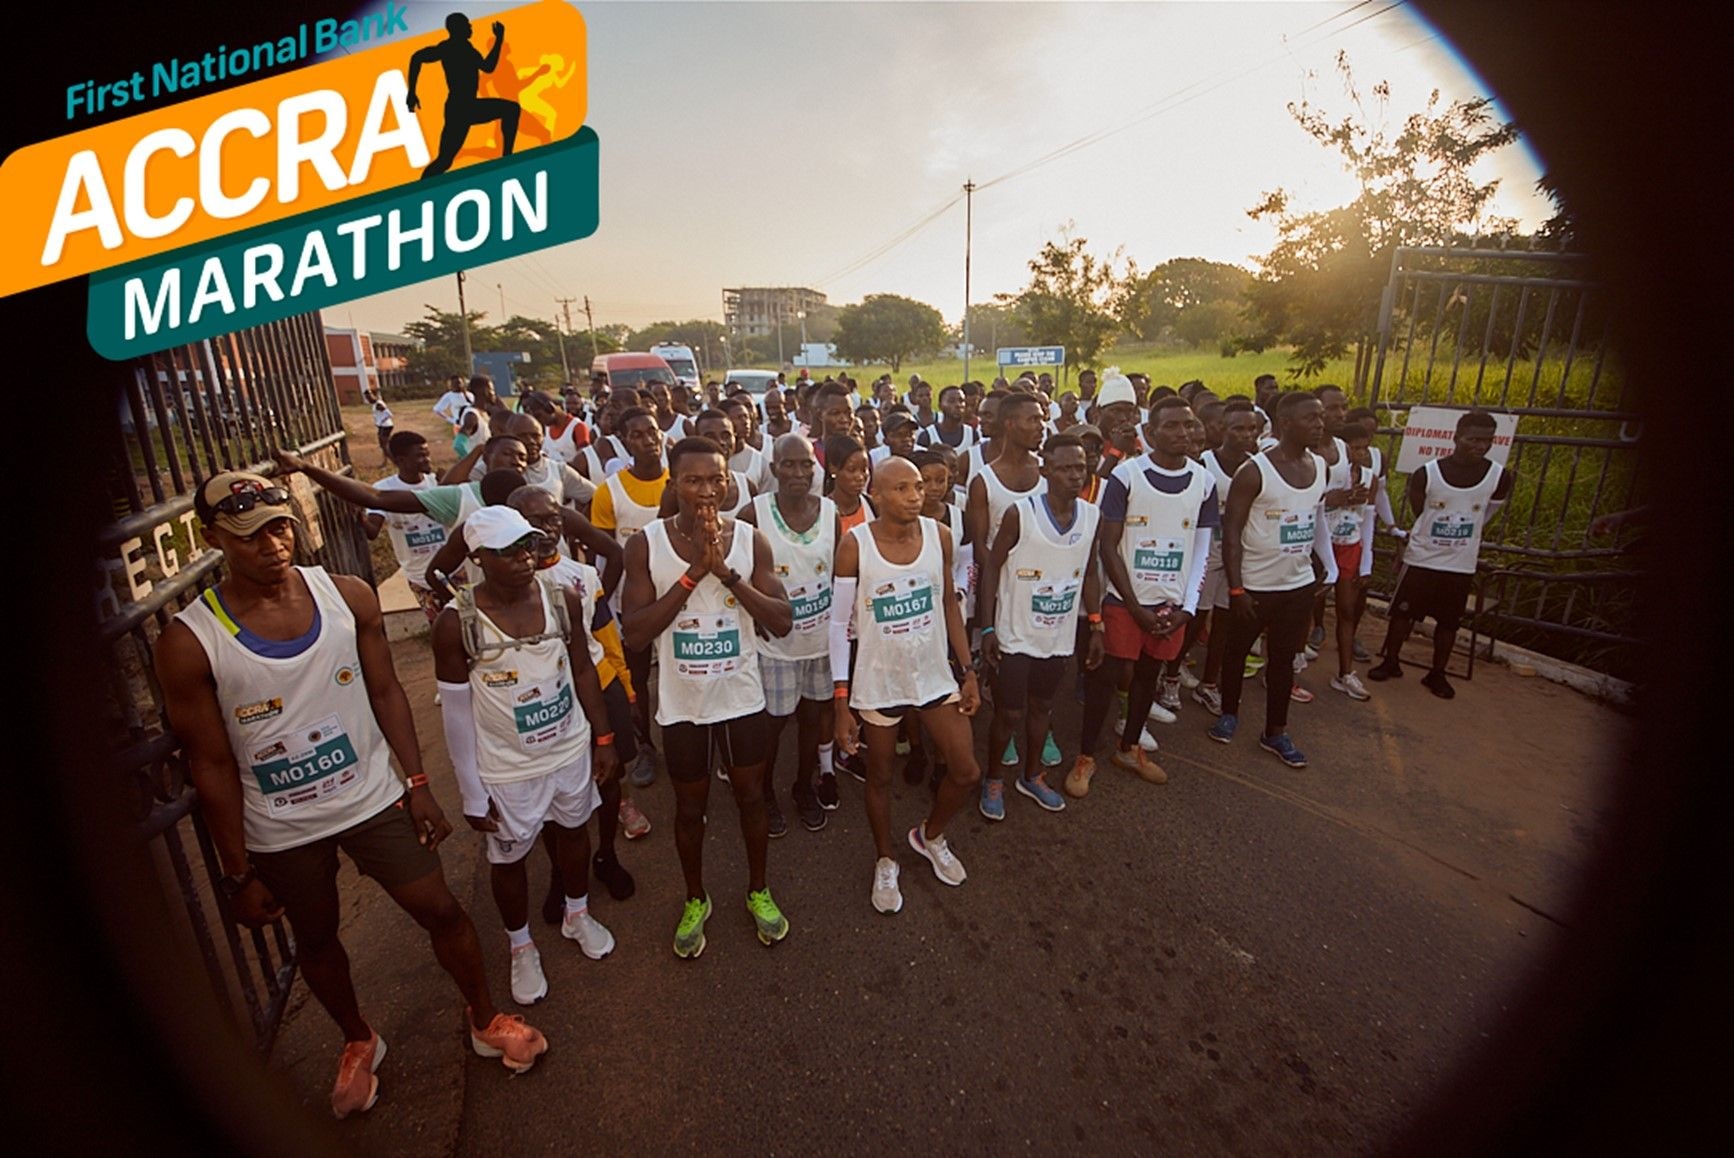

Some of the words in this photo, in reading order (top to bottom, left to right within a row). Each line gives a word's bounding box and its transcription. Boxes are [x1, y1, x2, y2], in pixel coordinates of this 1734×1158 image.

[1404, 427, 1455, 441] DIPLOMAT
[1418, 446, 1432, 456] NO
[1434, 446, 1453, 457] TRE
